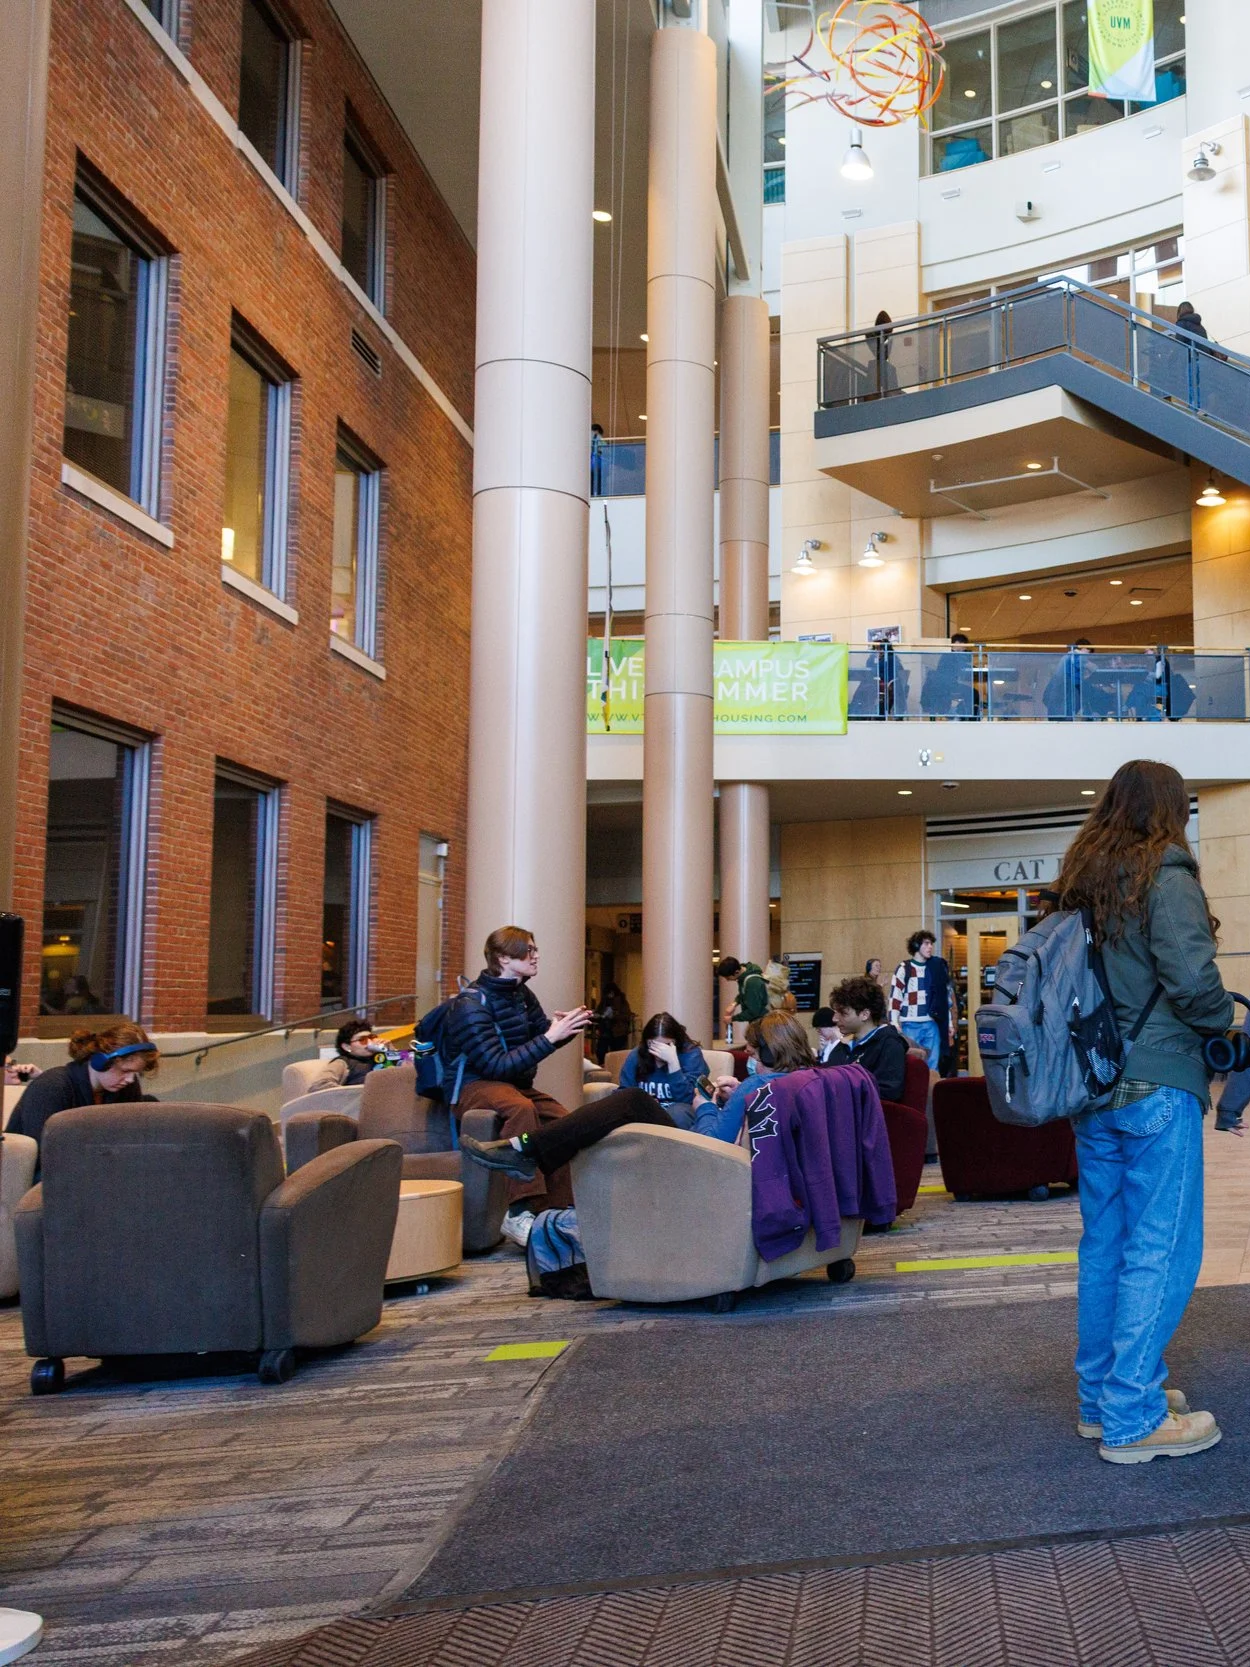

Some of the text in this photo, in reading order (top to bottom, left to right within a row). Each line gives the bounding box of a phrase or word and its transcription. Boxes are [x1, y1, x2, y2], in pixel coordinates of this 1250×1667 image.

[1110, 16, 1131, 29] UVM
[587, 656, 810, 679] LVE AMPUS
[587, 680, 808, 702] THI MMER
[994, 859, 1044, 881] CAT
